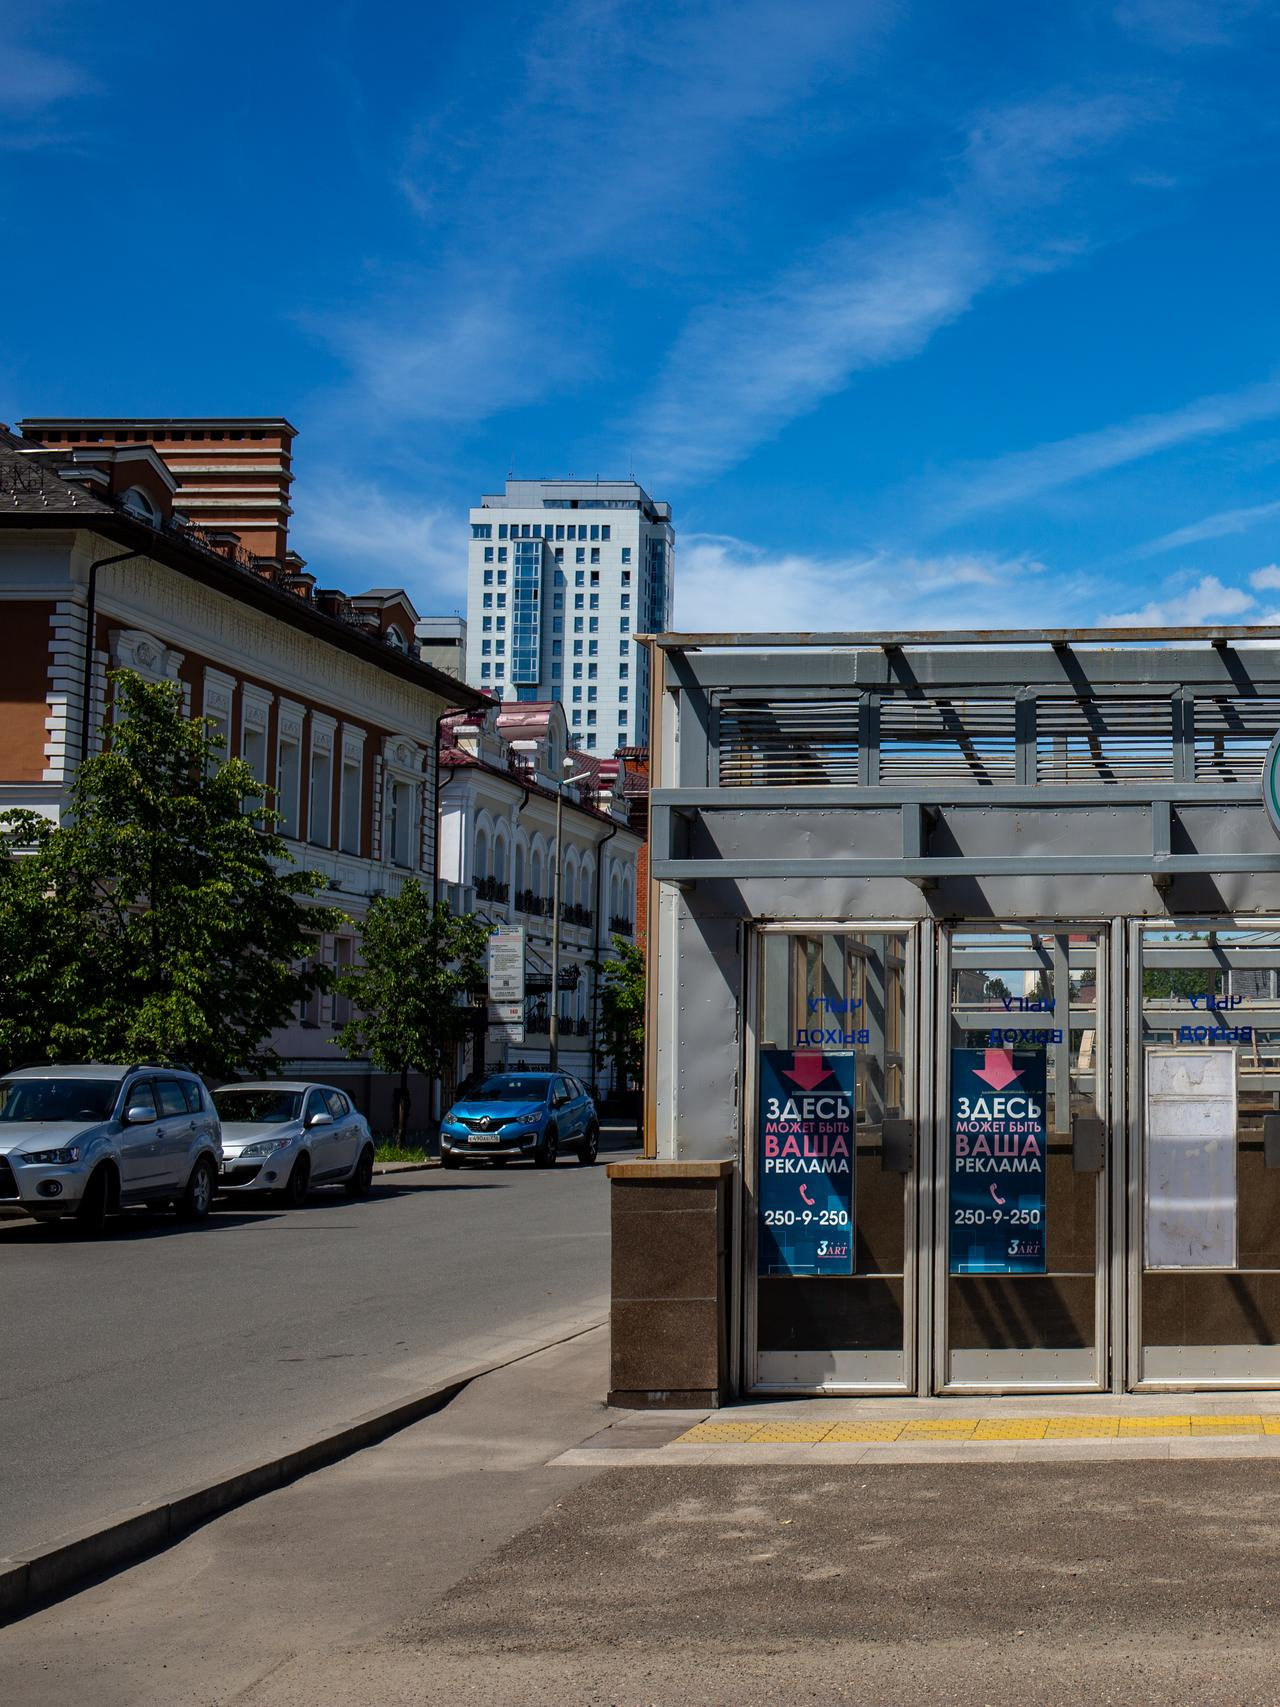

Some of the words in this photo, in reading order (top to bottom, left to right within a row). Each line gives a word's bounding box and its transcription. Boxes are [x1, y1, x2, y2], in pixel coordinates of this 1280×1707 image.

[766, 1098, 850, 1121] ЗДЕСЬ
[956, 1097, 1042, 1121] ЗДЕСЬ
[765, 1122, 815, 1134] МОЖЕТ
[819, 1122, 850, 1134] БЫТЬ
[956, 1121, 1006, 1133] МОЖЕТ
[1009, 1121, 1042, 1133] БЫТЬ
[765, 1135, 849, 1157] ВАША
[955, 1134, 1041, 1156] ВАША
[765, 1158, 850, 1173] РЕКЛАМА
[955, 1158, 1042, 1173] РЕКЛАМА
[764, 1210, 848, 1225] 250-9-250
[954, 1209, 1041, 1224] 250-9-250
